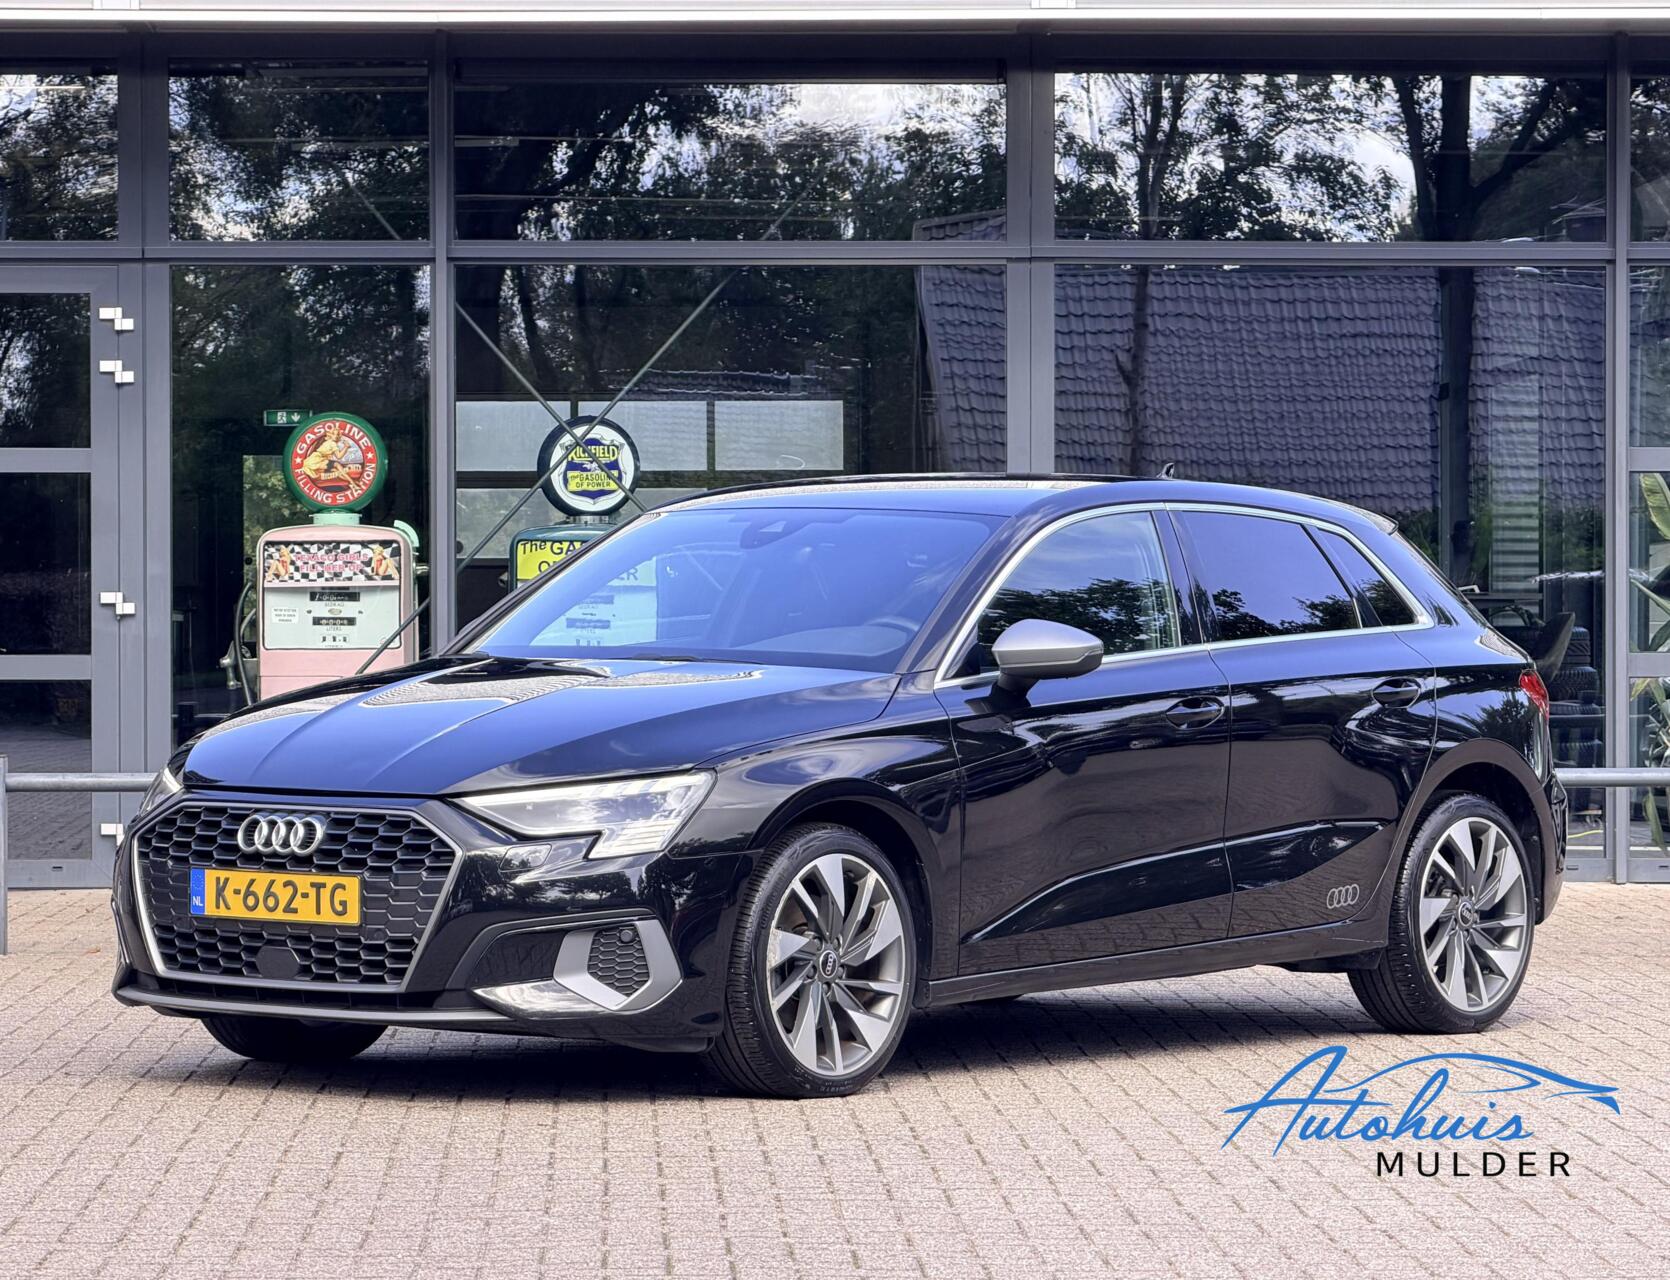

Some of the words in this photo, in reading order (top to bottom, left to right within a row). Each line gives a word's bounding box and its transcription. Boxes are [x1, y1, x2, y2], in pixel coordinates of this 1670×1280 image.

[296, 422, 372, 454] GASOLINE
[295, 467, 333, 503] FILLING
[336, 463, 376, 503] STATION
[575, 481, 584, 489] OF
[521, 540, 547, 555] The
[293, 553, 335, 562] TEXACO
[337, 552, 369, 562] GIRLS
[192, 896, 204, 907] NL
[214, 876, 348, 917] K-662-TG
